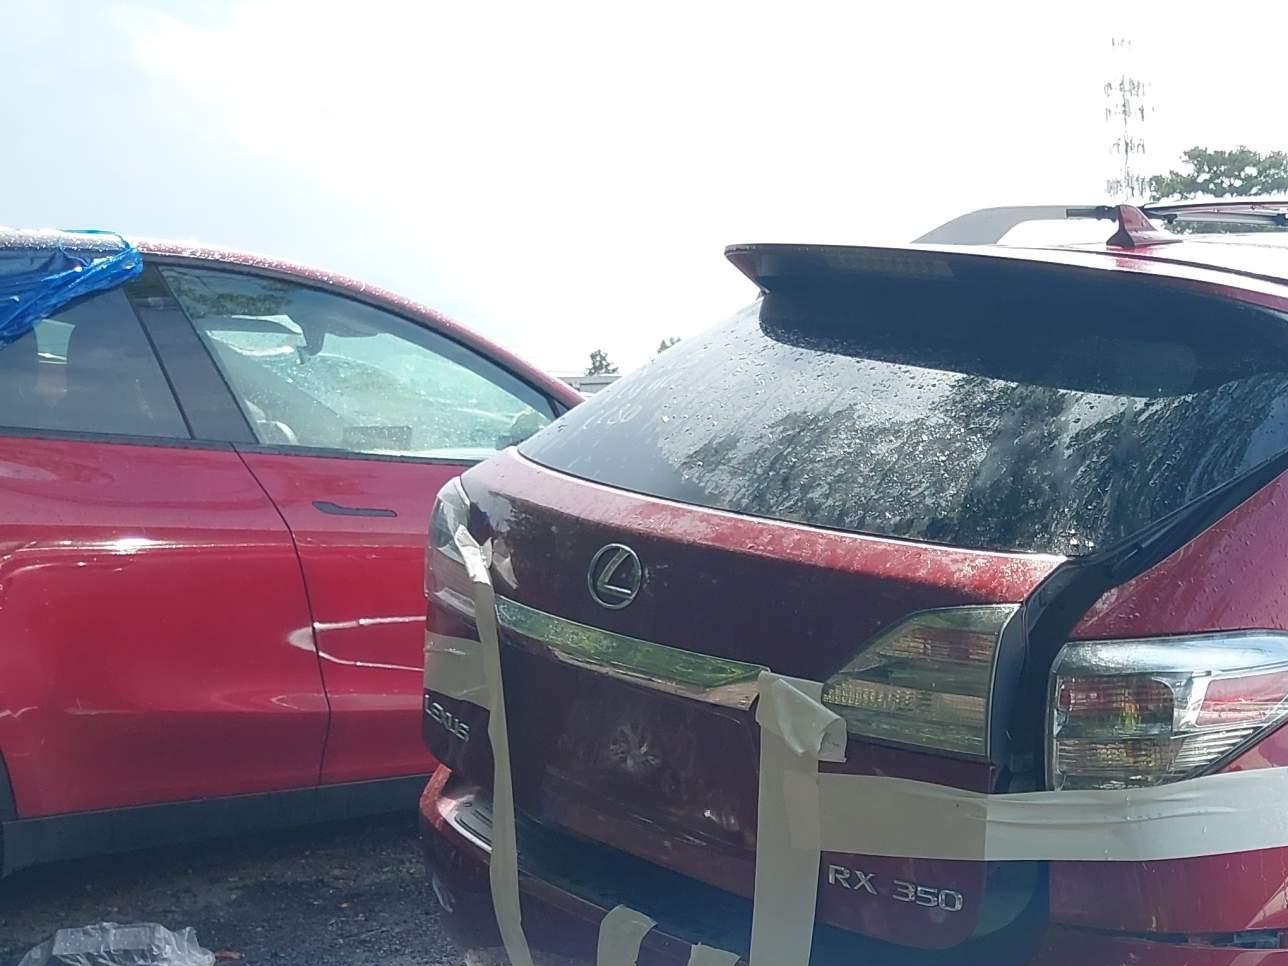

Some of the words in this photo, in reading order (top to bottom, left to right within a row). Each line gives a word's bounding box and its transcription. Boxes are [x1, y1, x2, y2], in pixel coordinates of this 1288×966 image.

[424, 694, 470, 742] LEXUS
[828, 864, 878, 895] RX
[892, 879, 963, 912] 350
